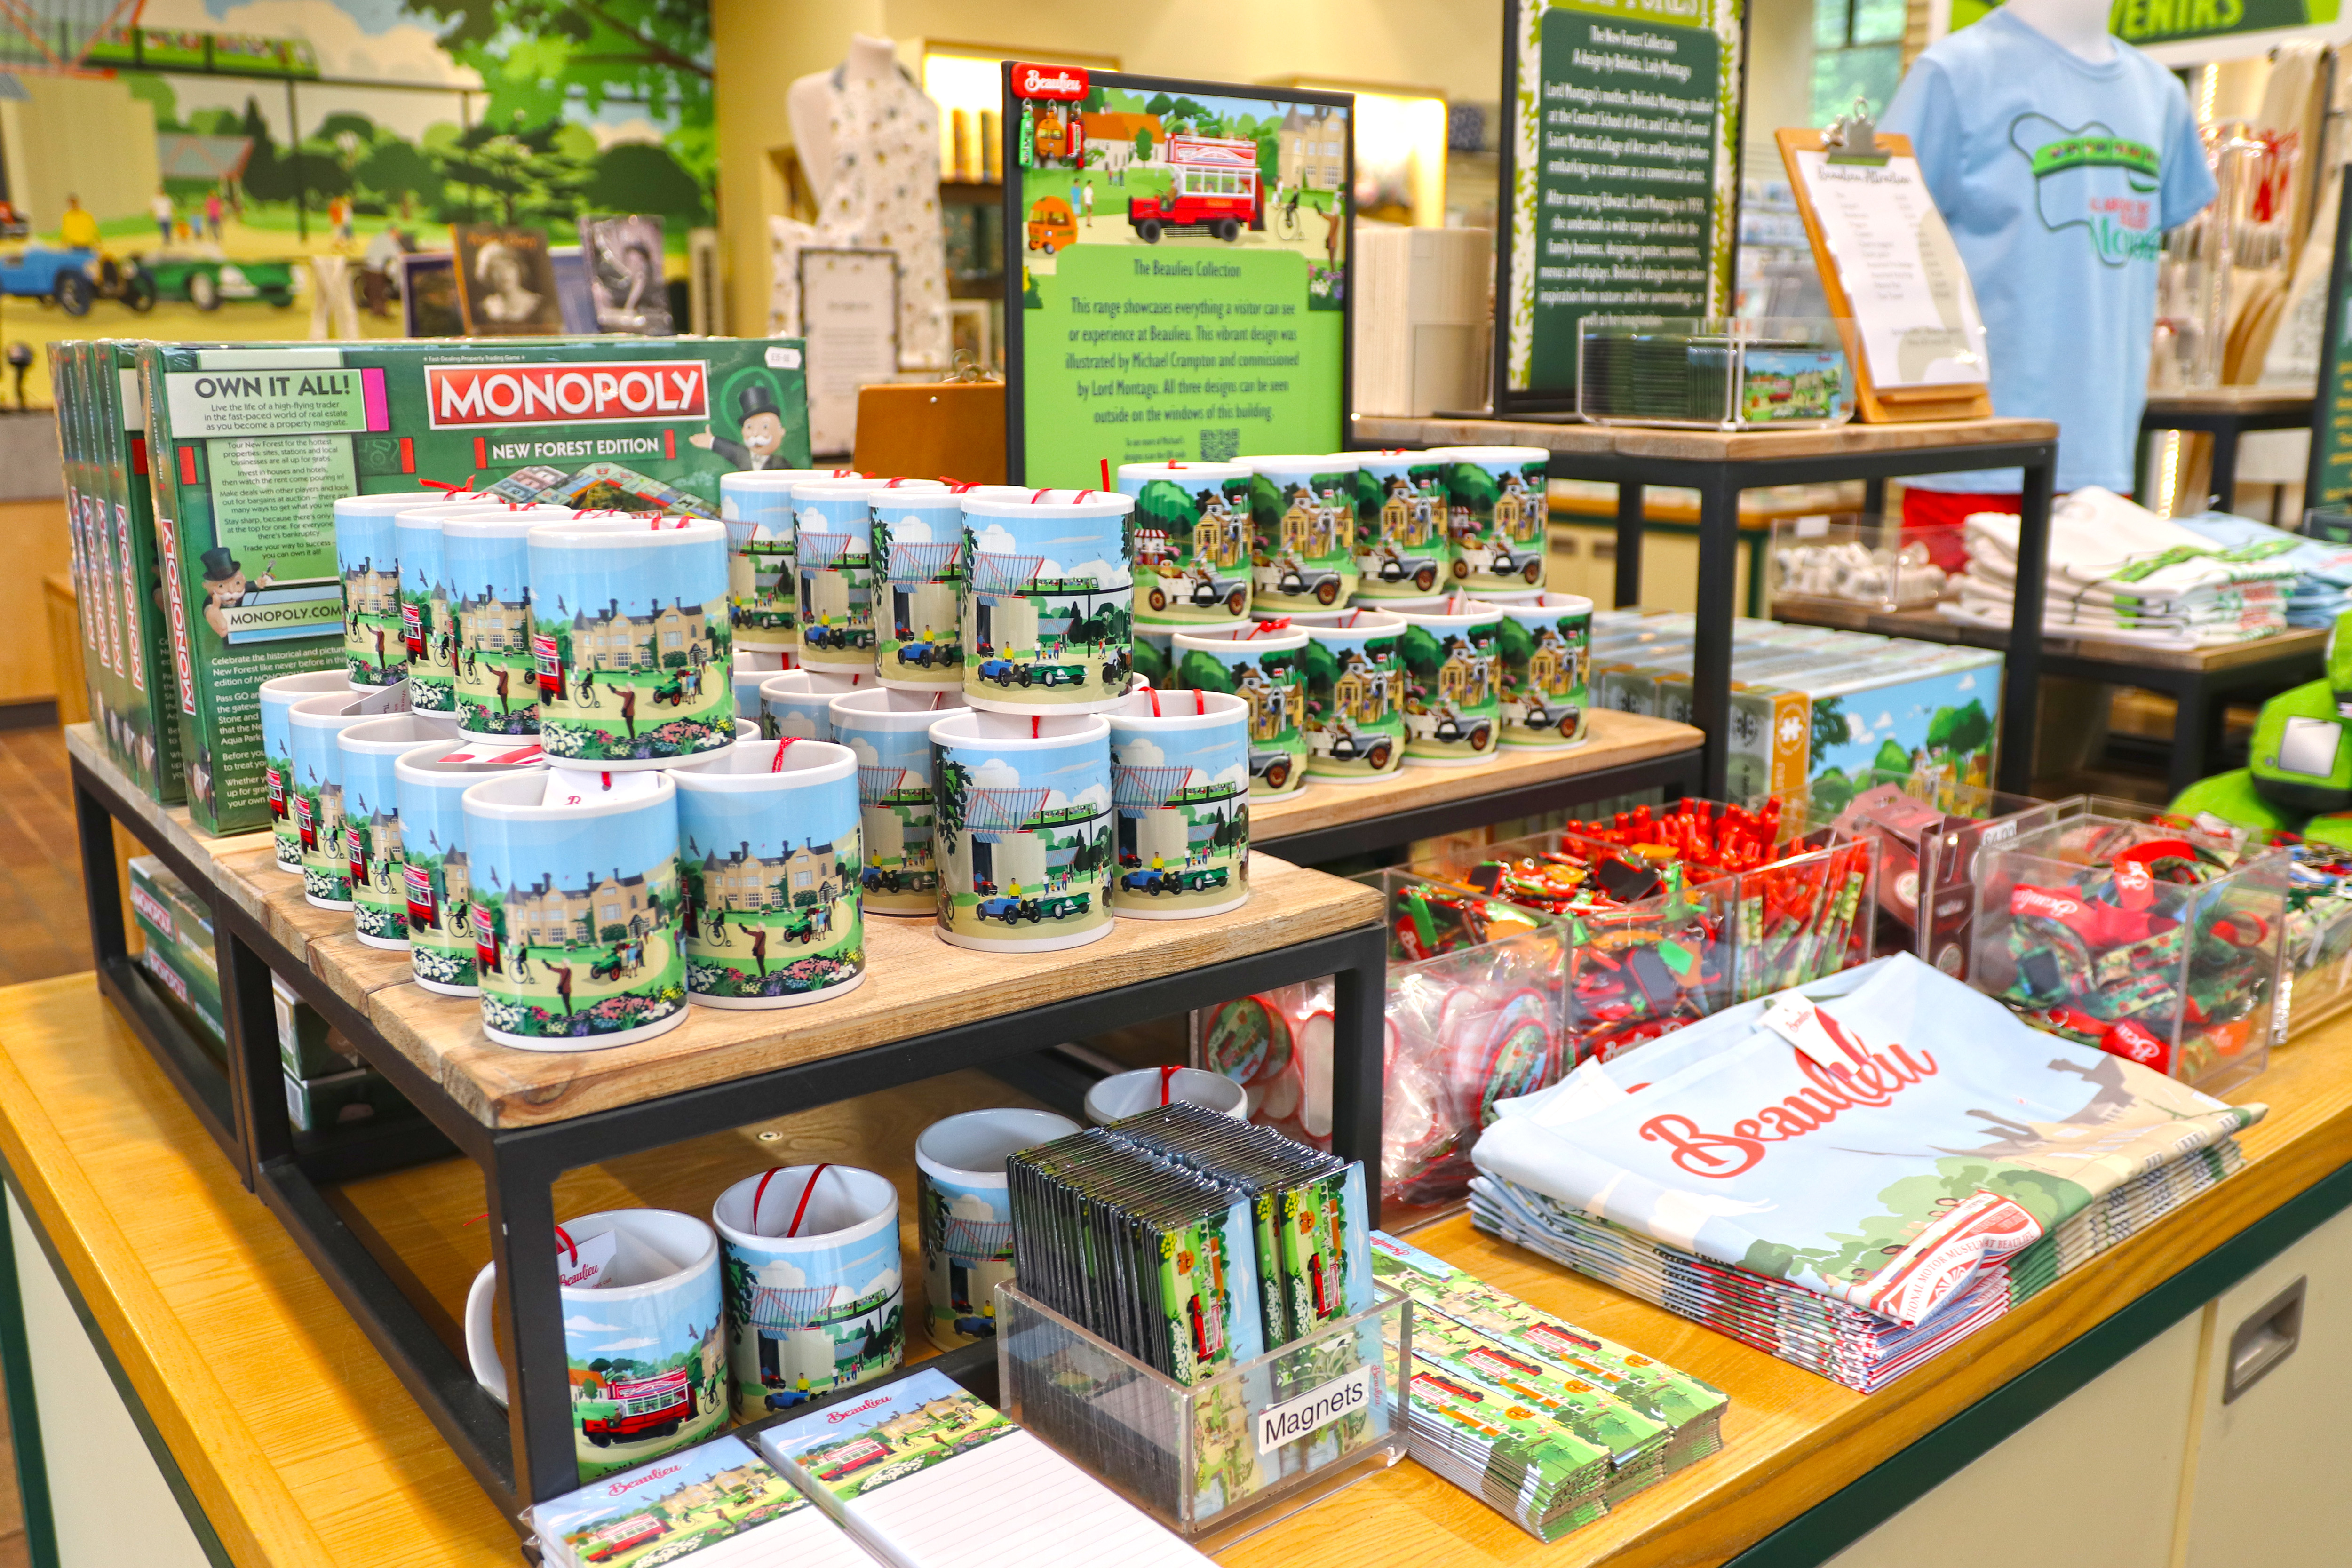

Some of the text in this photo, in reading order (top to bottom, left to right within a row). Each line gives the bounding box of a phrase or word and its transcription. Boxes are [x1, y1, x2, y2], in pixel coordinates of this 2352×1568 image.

[1134, 259, 1241, 279] The Beaulieu Collection
[1071, 297, 1295, 319] This range showcases everything a visitor can see
[1069, 330, 1079, 341] or
[1083, 326, 1135, 345] experience
[1138, 328, 1147, 341] at
[1196, 325, 1213, 341] This
[1216, 325, 1248, 341] vibrant
[1251, 324, 1278, 344] design
[1280, 329, 1296, 341] was
[1065, 350, 1299, 372] illustrated by Michael Crampton and commissioned
[195, 375, 350, 398] OWN IT ALL!
[441, 370, 699, 418] MONOPOLY
[1077, 381, 1089, 400] by
[1092, 380, 1113, 396] Lord
[1163, 378, 1175, 394] All
[1178, 379, 1201, 394] three
[1204, 377, 1237, 398] designs
[1240, 381, 1255, 392] can
[1257, 378, 1267, 392] be
[1270, 379, 1288, 391] seen
[275, 401, 314, 411] high-flying
[1094, 406, 1128, 423] outside
[1132, 410, 1144, 422] on
[1147, 406, 1161, 421] the
[1164, 405, 1203, 421] windows
[1207, 404, 1216, 420] of
[1219, 403, 1233, 419] this
[229, 412, 271, 422] fast-paced
[277, 421, 311, 429] property
[493, 437, 659, 459] NEW FOREST EDITION
[231, 457, 268, 466] businesses
[98, 502, 123, 673] MONOPOLY
[117, 508, 141, 683] MONOPOLY
[163, 523, 194, 708] MONOPOLY
[230, 606, 342, 626] MONOPOLY.COM
[212, 655, 251, 666] Celebrate
[252, 653, 265, 662] the
[267, 651, 302, 660] historical
[274, 662, 297, 670] never
[298, 659, 325, 668] before
[214, 678, 243, 688] edition
[216, 694, 233, 703] Pass
[218, 716, 242, 724] Stone
[221, 733, 262, 746] Aqua Park
[225, 776, 259, 787] Whether
[1920, 1253, 1948, 1283] MOTOR
[1997, 1229, 2036, 1249] BEAULIEU
[559, 1263, 599, 1286] Beaulieu
[1371, 1364, 1383, 1407] Beaulieu
[827, 1395, 893, 1425] Beaulieu
[1266, 1382, 1363, 1445] Magnets
[608, 1464, 683, 1497] Beaulieu
